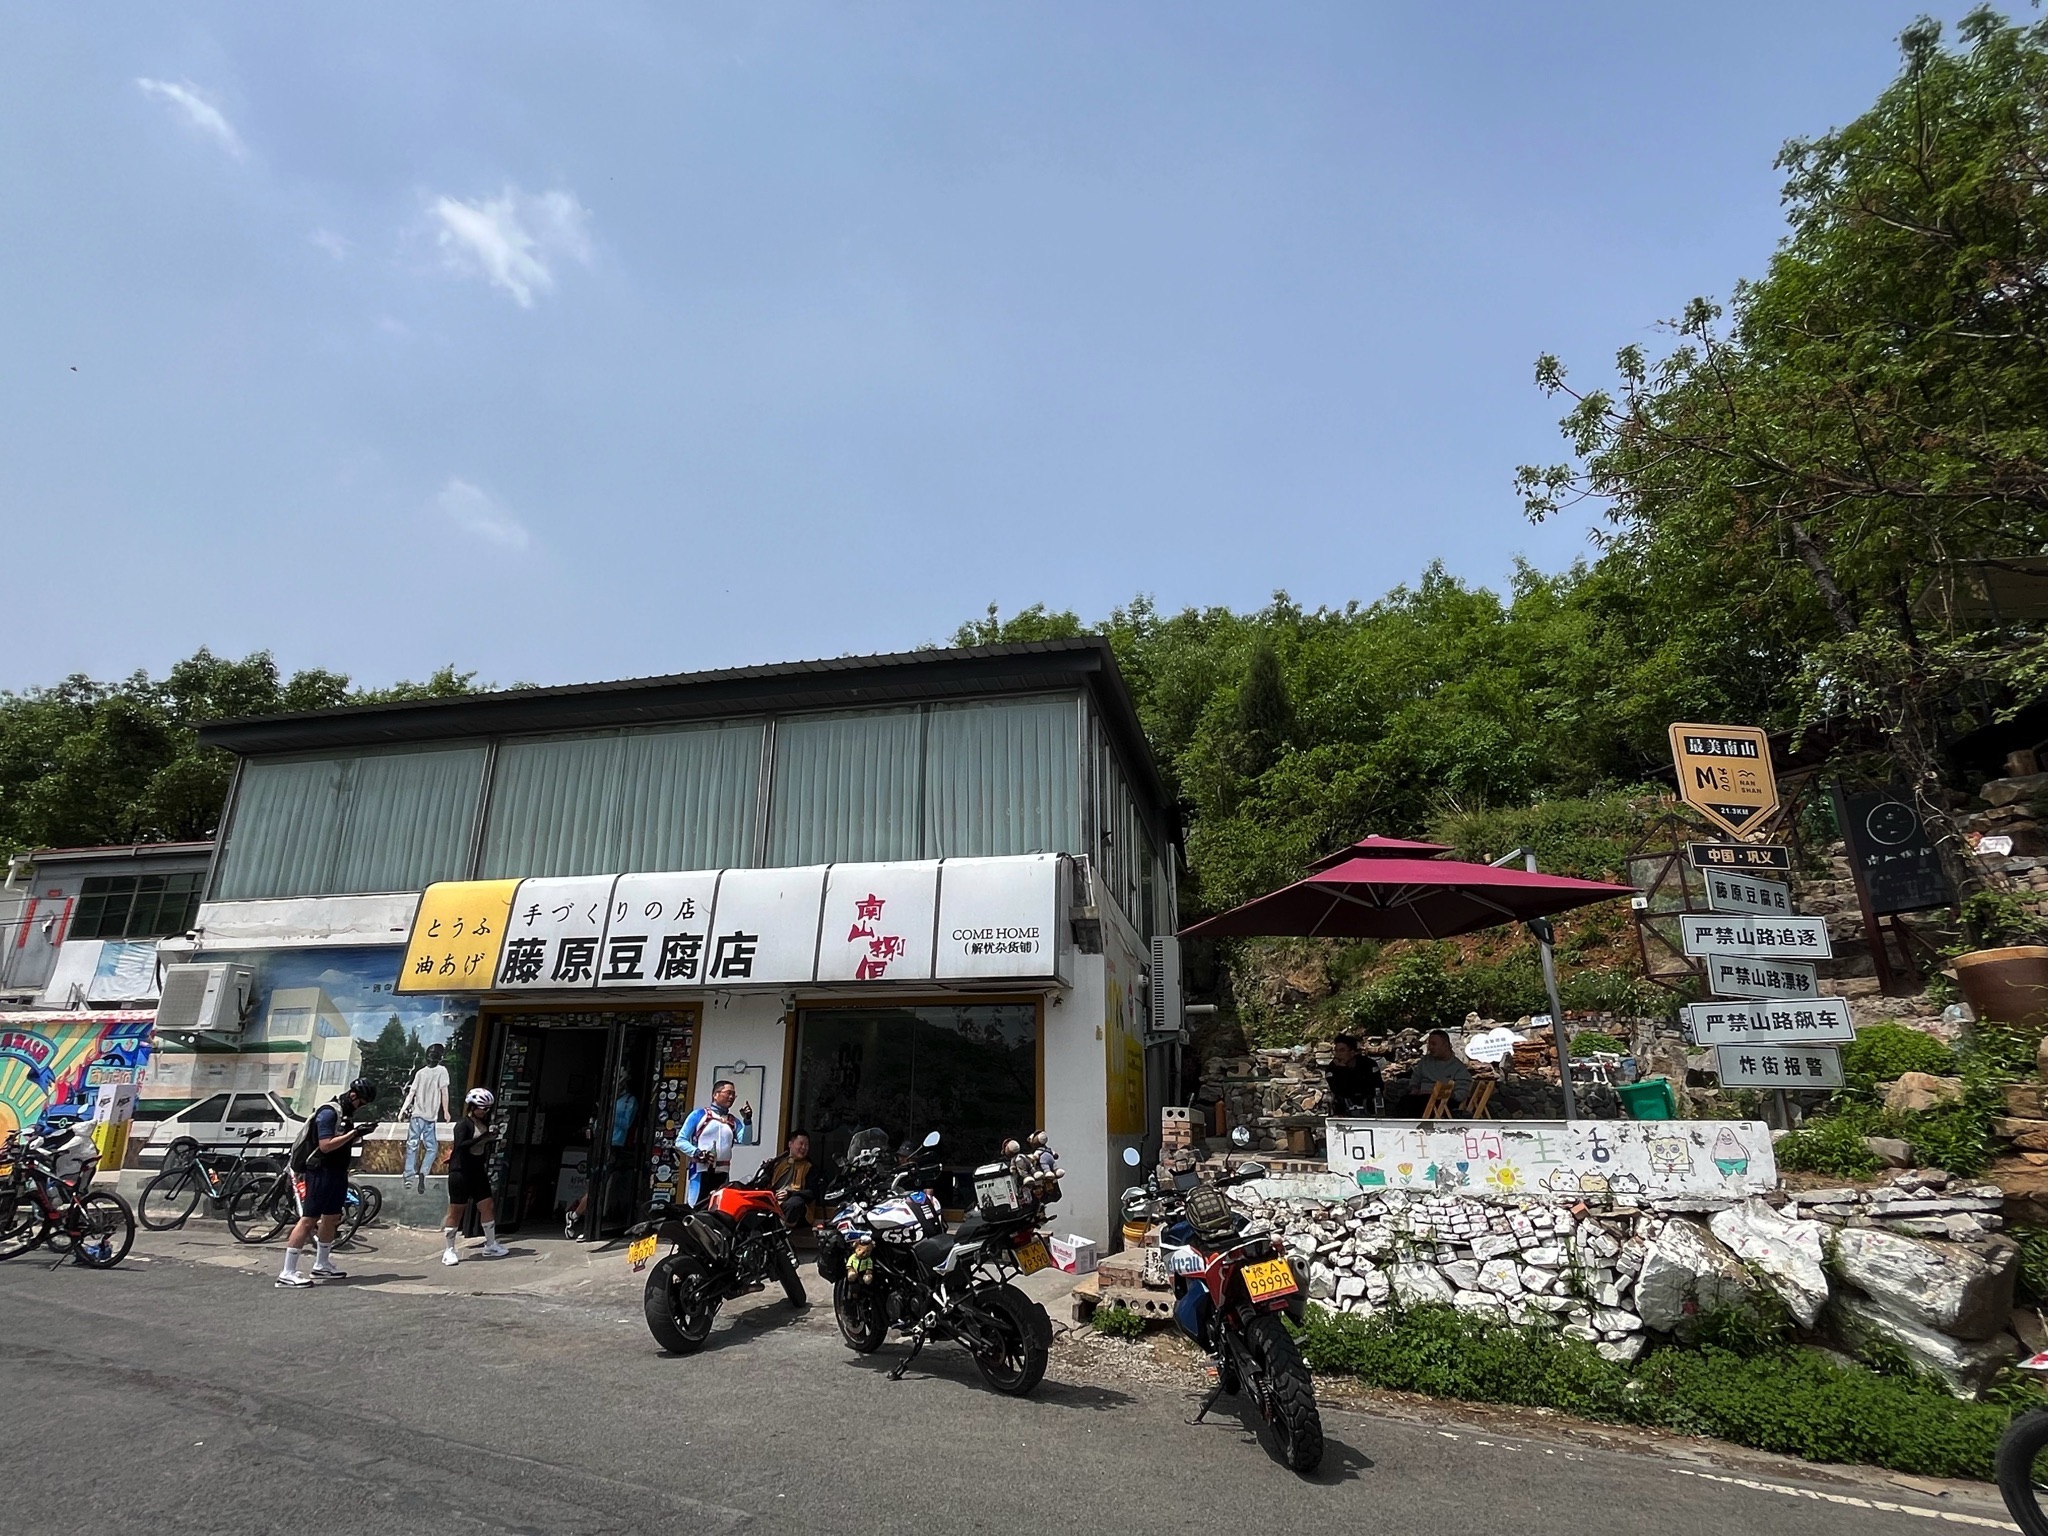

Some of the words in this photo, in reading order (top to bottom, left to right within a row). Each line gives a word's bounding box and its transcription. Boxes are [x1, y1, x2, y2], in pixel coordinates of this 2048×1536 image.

[1689, 738, 1756, 757] 最美南山
[1707, 848, 1775, 865] 中国·巩义
[1714, 880, 1787, 909] 藤原豆腐店
[522, 897, 695, 927] 手づくりの店
[427, 917, 491, 939] とうふ
[952, 928, 993, 941] COME
[996, 927, 1040, 940] HOME
[1695, 926, 1818, 947] 严禁山路追逐
[415, 952, 486, 976] 油あげ
[499, 929, 759, 984] 藤原豆腐店
[1719, 965, 1811, 992] 严禁山路漂移
[1739, 1055, 1824, 1077] 炸街报警
[1250, 1271, 1293, 1294] 9999R
